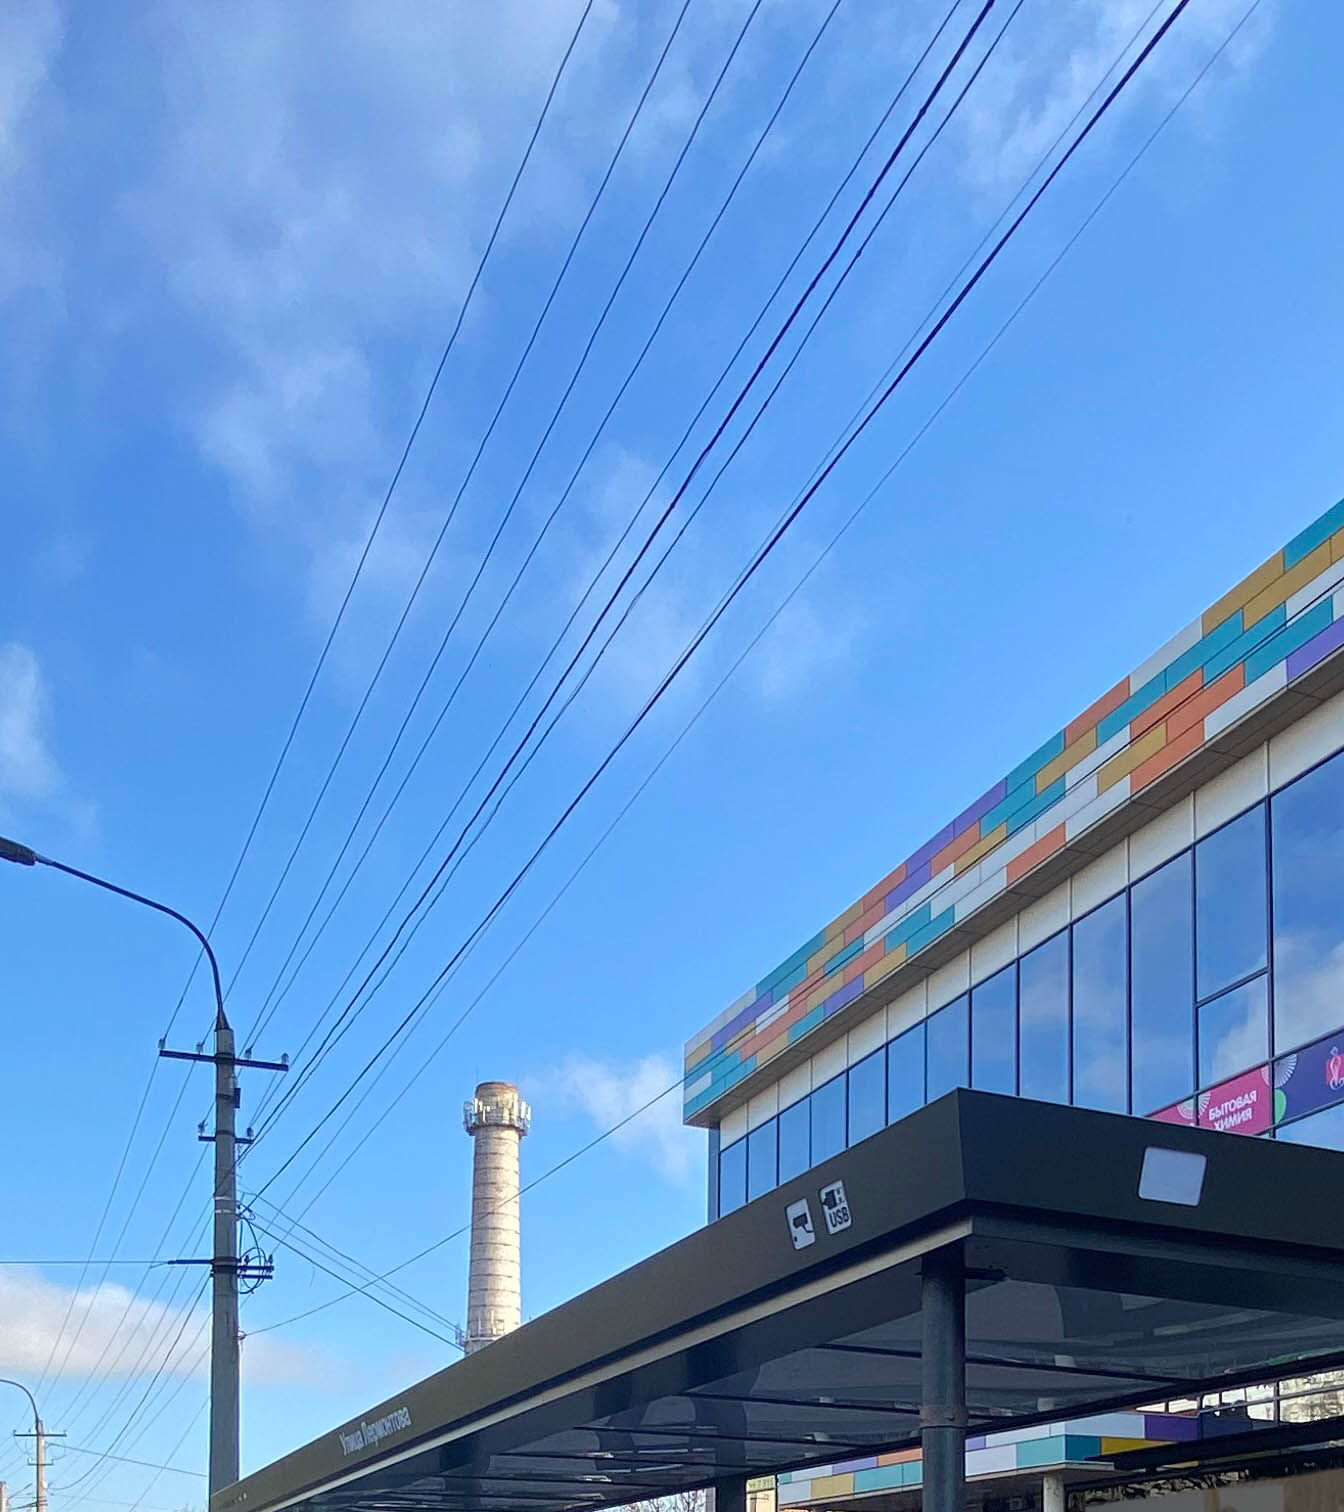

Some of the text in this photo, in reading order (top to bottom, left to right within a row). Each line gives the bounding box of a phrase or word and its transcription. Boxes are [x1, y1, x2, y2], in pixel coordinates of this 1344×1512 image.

[1209, 1090, 1256, 1120] БЫТОВАЯ
[1214, 1108, 1252, 1131] ХИМИЯ
[829, 1206, 850, 1228] USB
